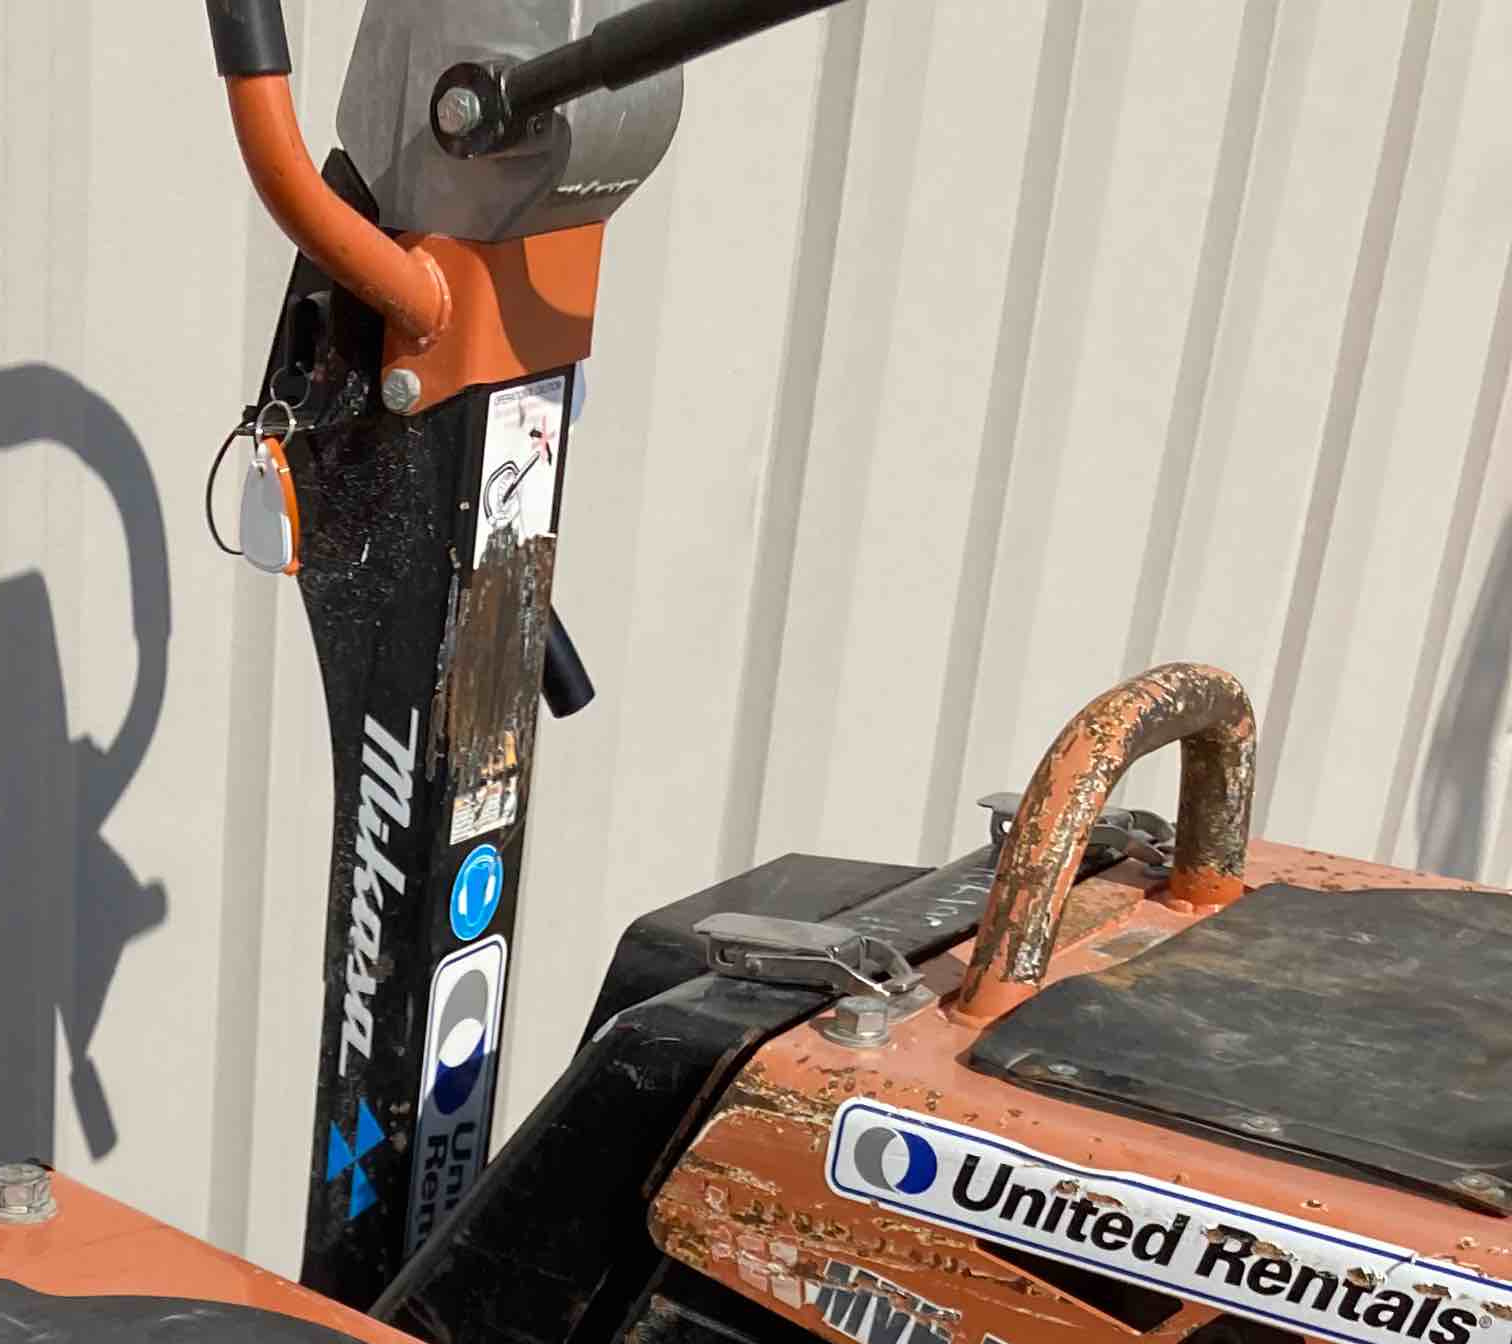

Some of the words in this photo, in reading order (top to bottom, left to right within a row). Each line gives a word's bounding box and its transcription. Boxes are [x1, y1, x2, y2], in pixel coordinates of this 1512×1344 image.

[338, 708, 420, 1077] Mikasa
[415, 1134, 449, 1249] Ren
[952, 1154, 1192, 1267] United
